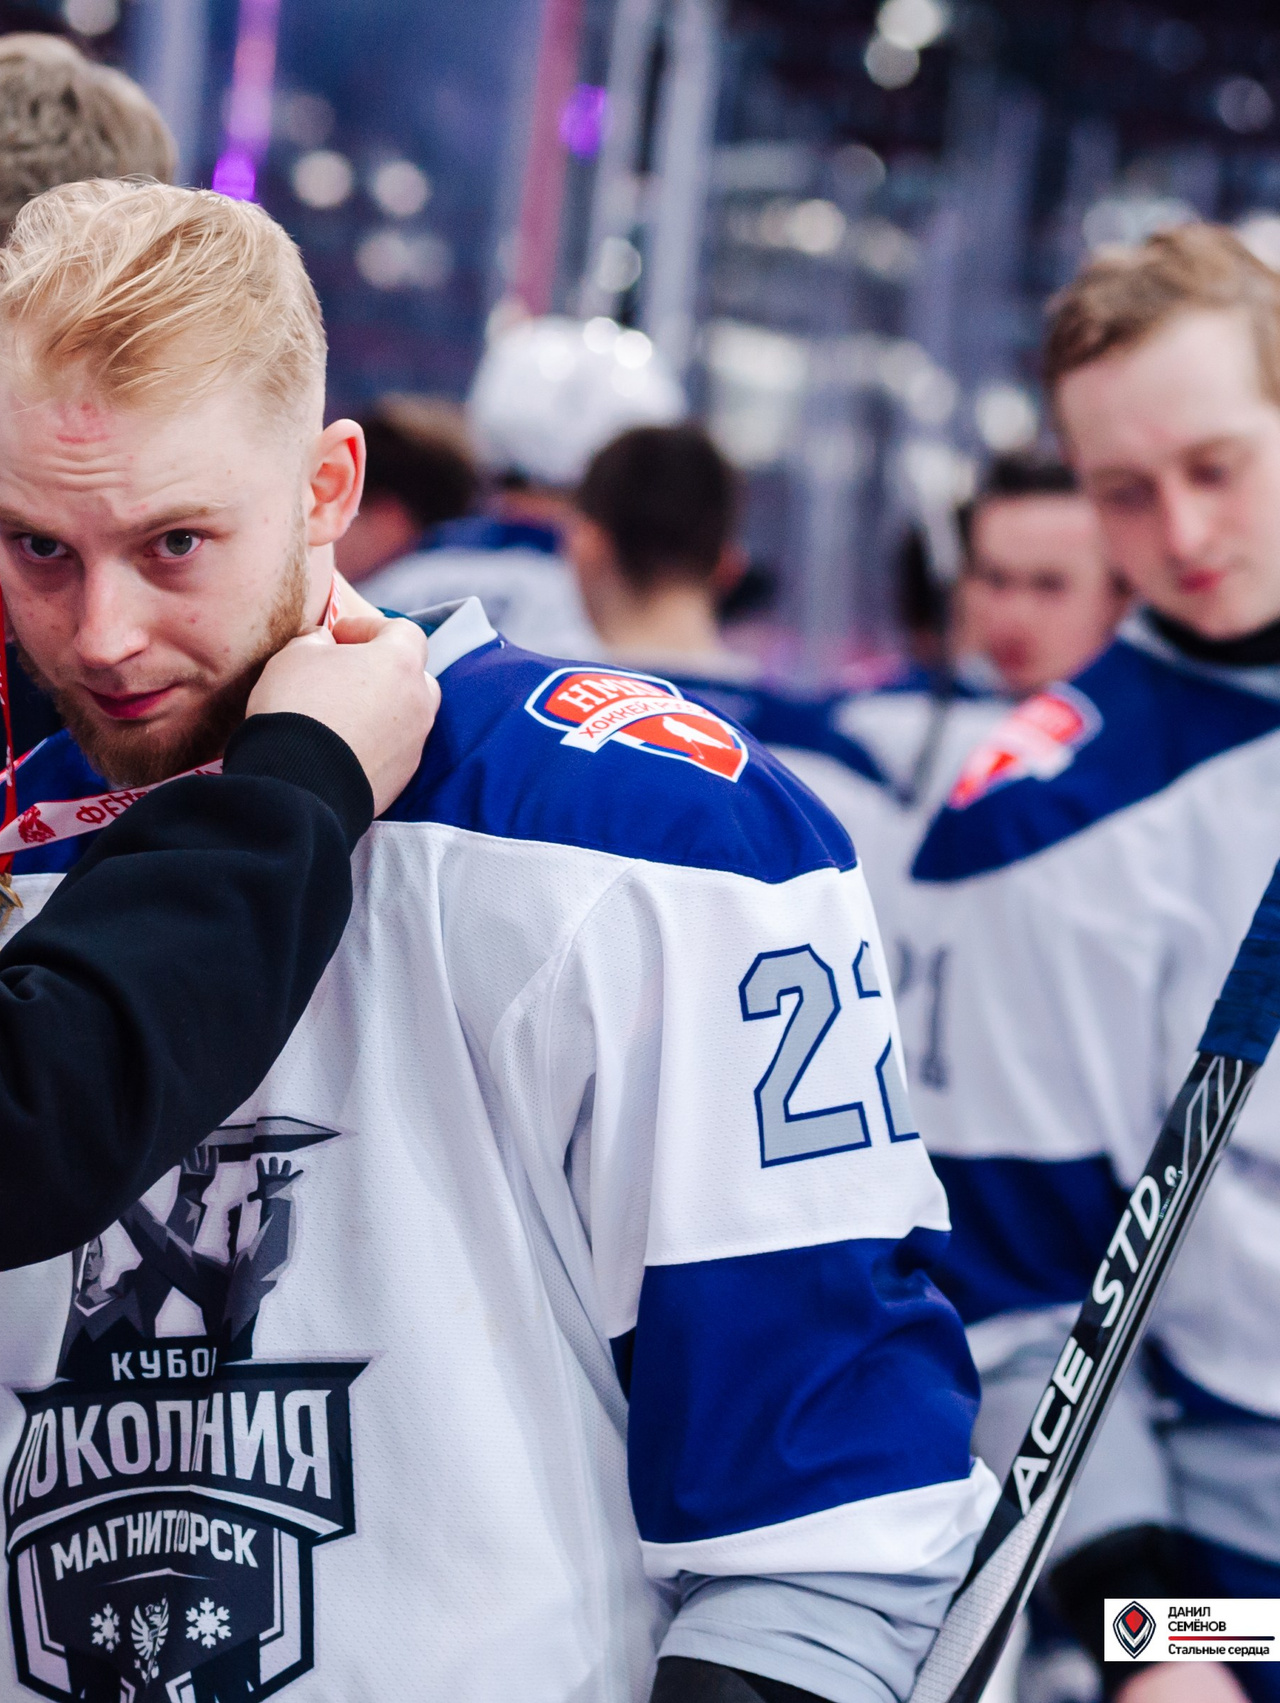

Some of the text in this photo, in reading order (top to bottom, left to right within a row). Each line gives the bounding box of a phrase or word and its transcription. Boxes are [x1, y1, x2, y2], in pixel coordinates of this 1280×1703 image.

[111, 1346, 217, 1381] КУБО
[1012, 1336, 1093, 1516] ACE
[9, 1389, 332, 1517] ПОКОЛНИЯ
